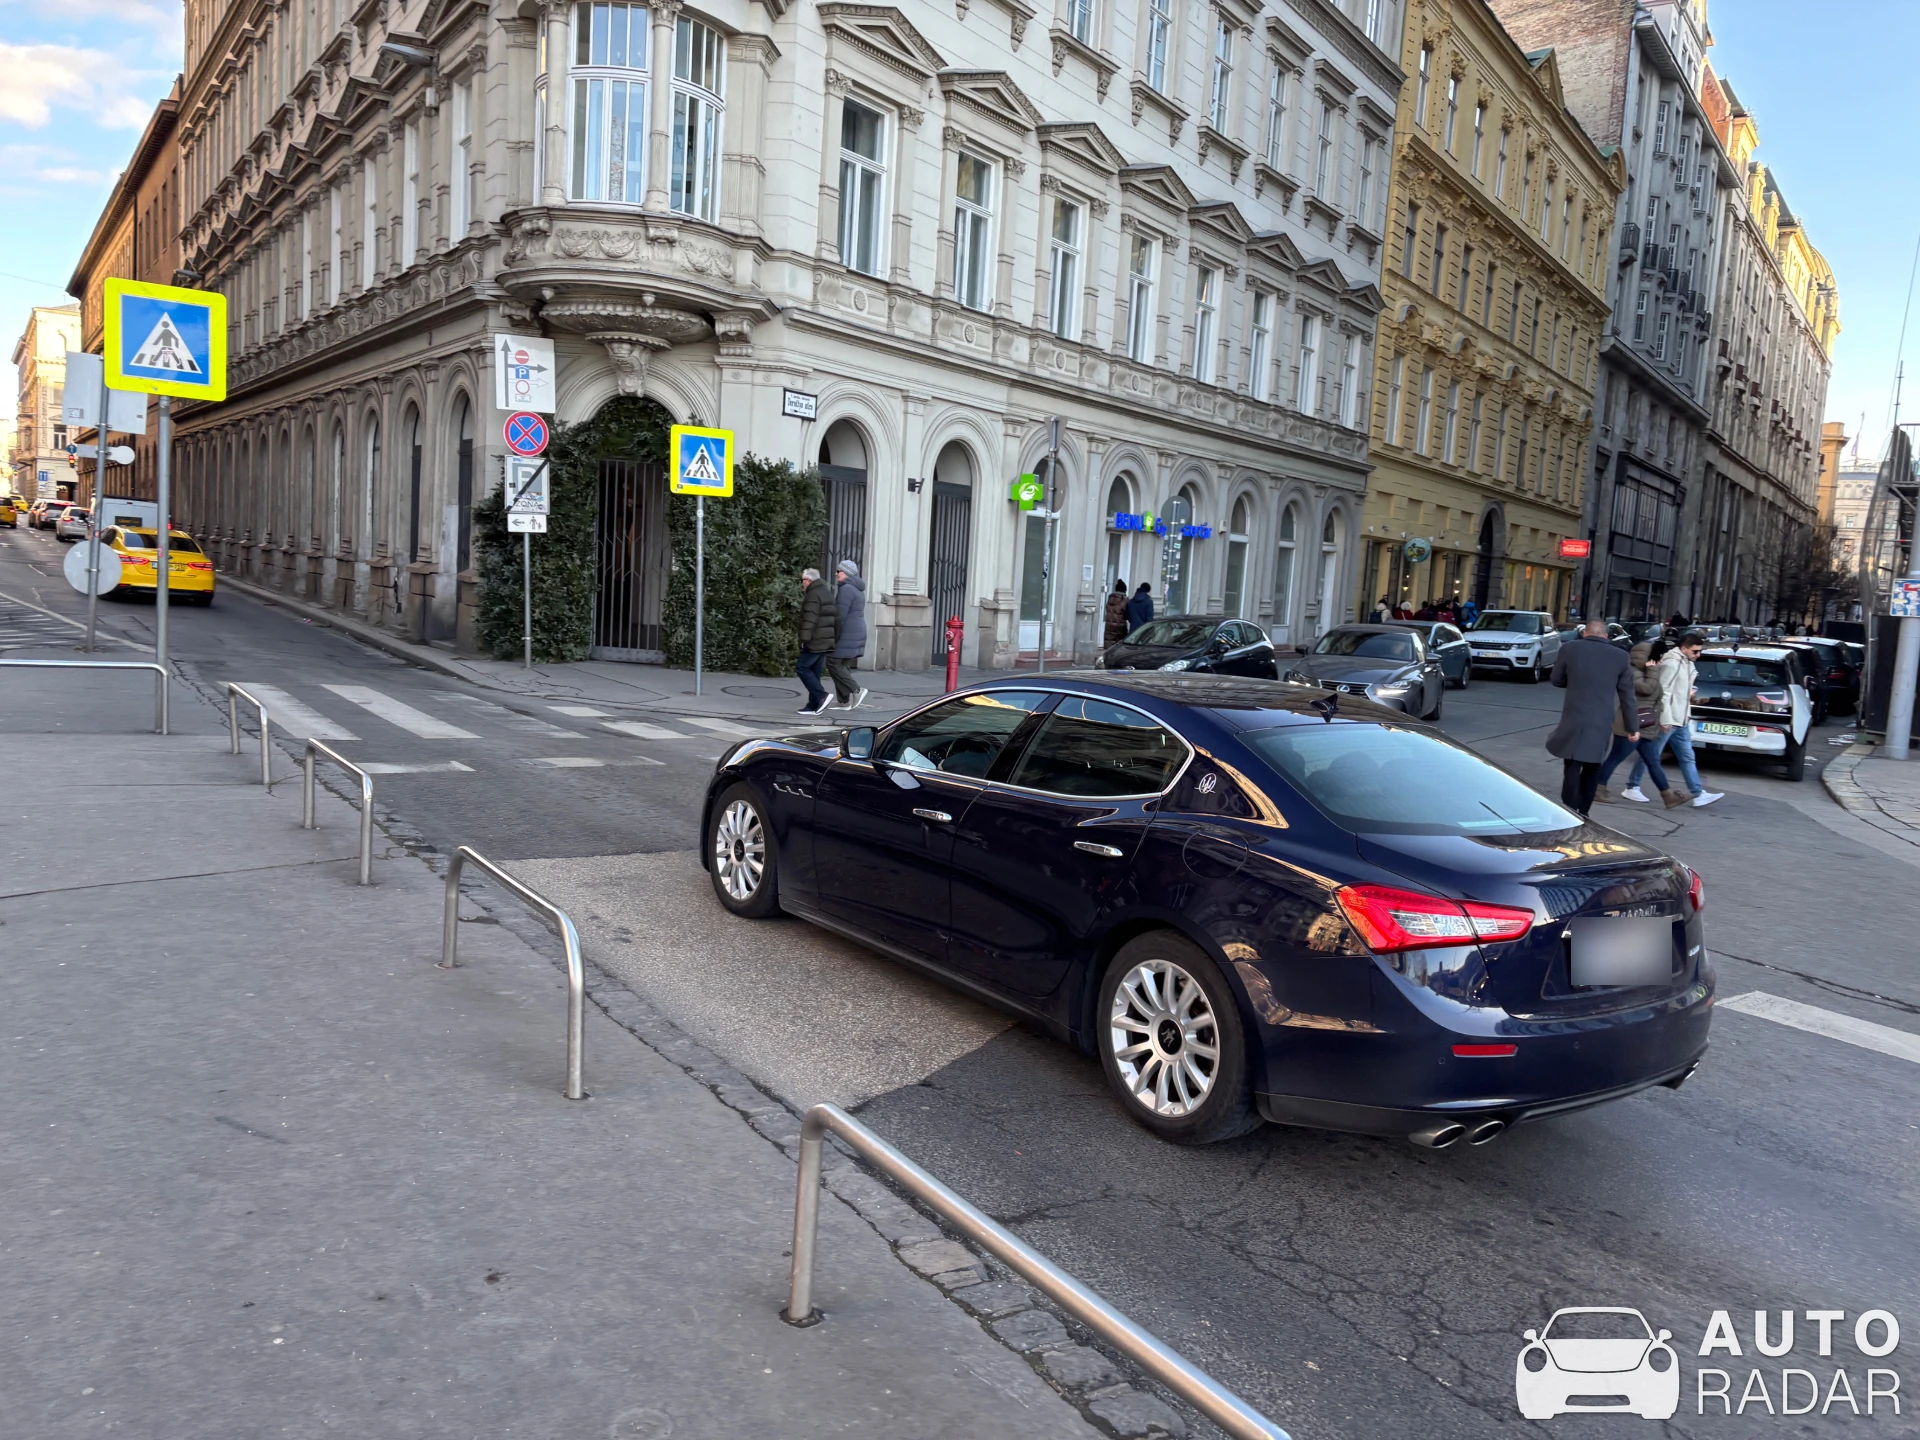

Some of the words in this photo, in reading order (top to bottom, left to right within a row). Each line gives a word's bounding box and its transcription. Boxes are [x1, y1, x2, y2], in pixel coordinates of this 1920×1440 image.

[519, 368, 527, 379] P
[517, 466, 536, 492] P
[1115, 511, 1144, 531] BENU
